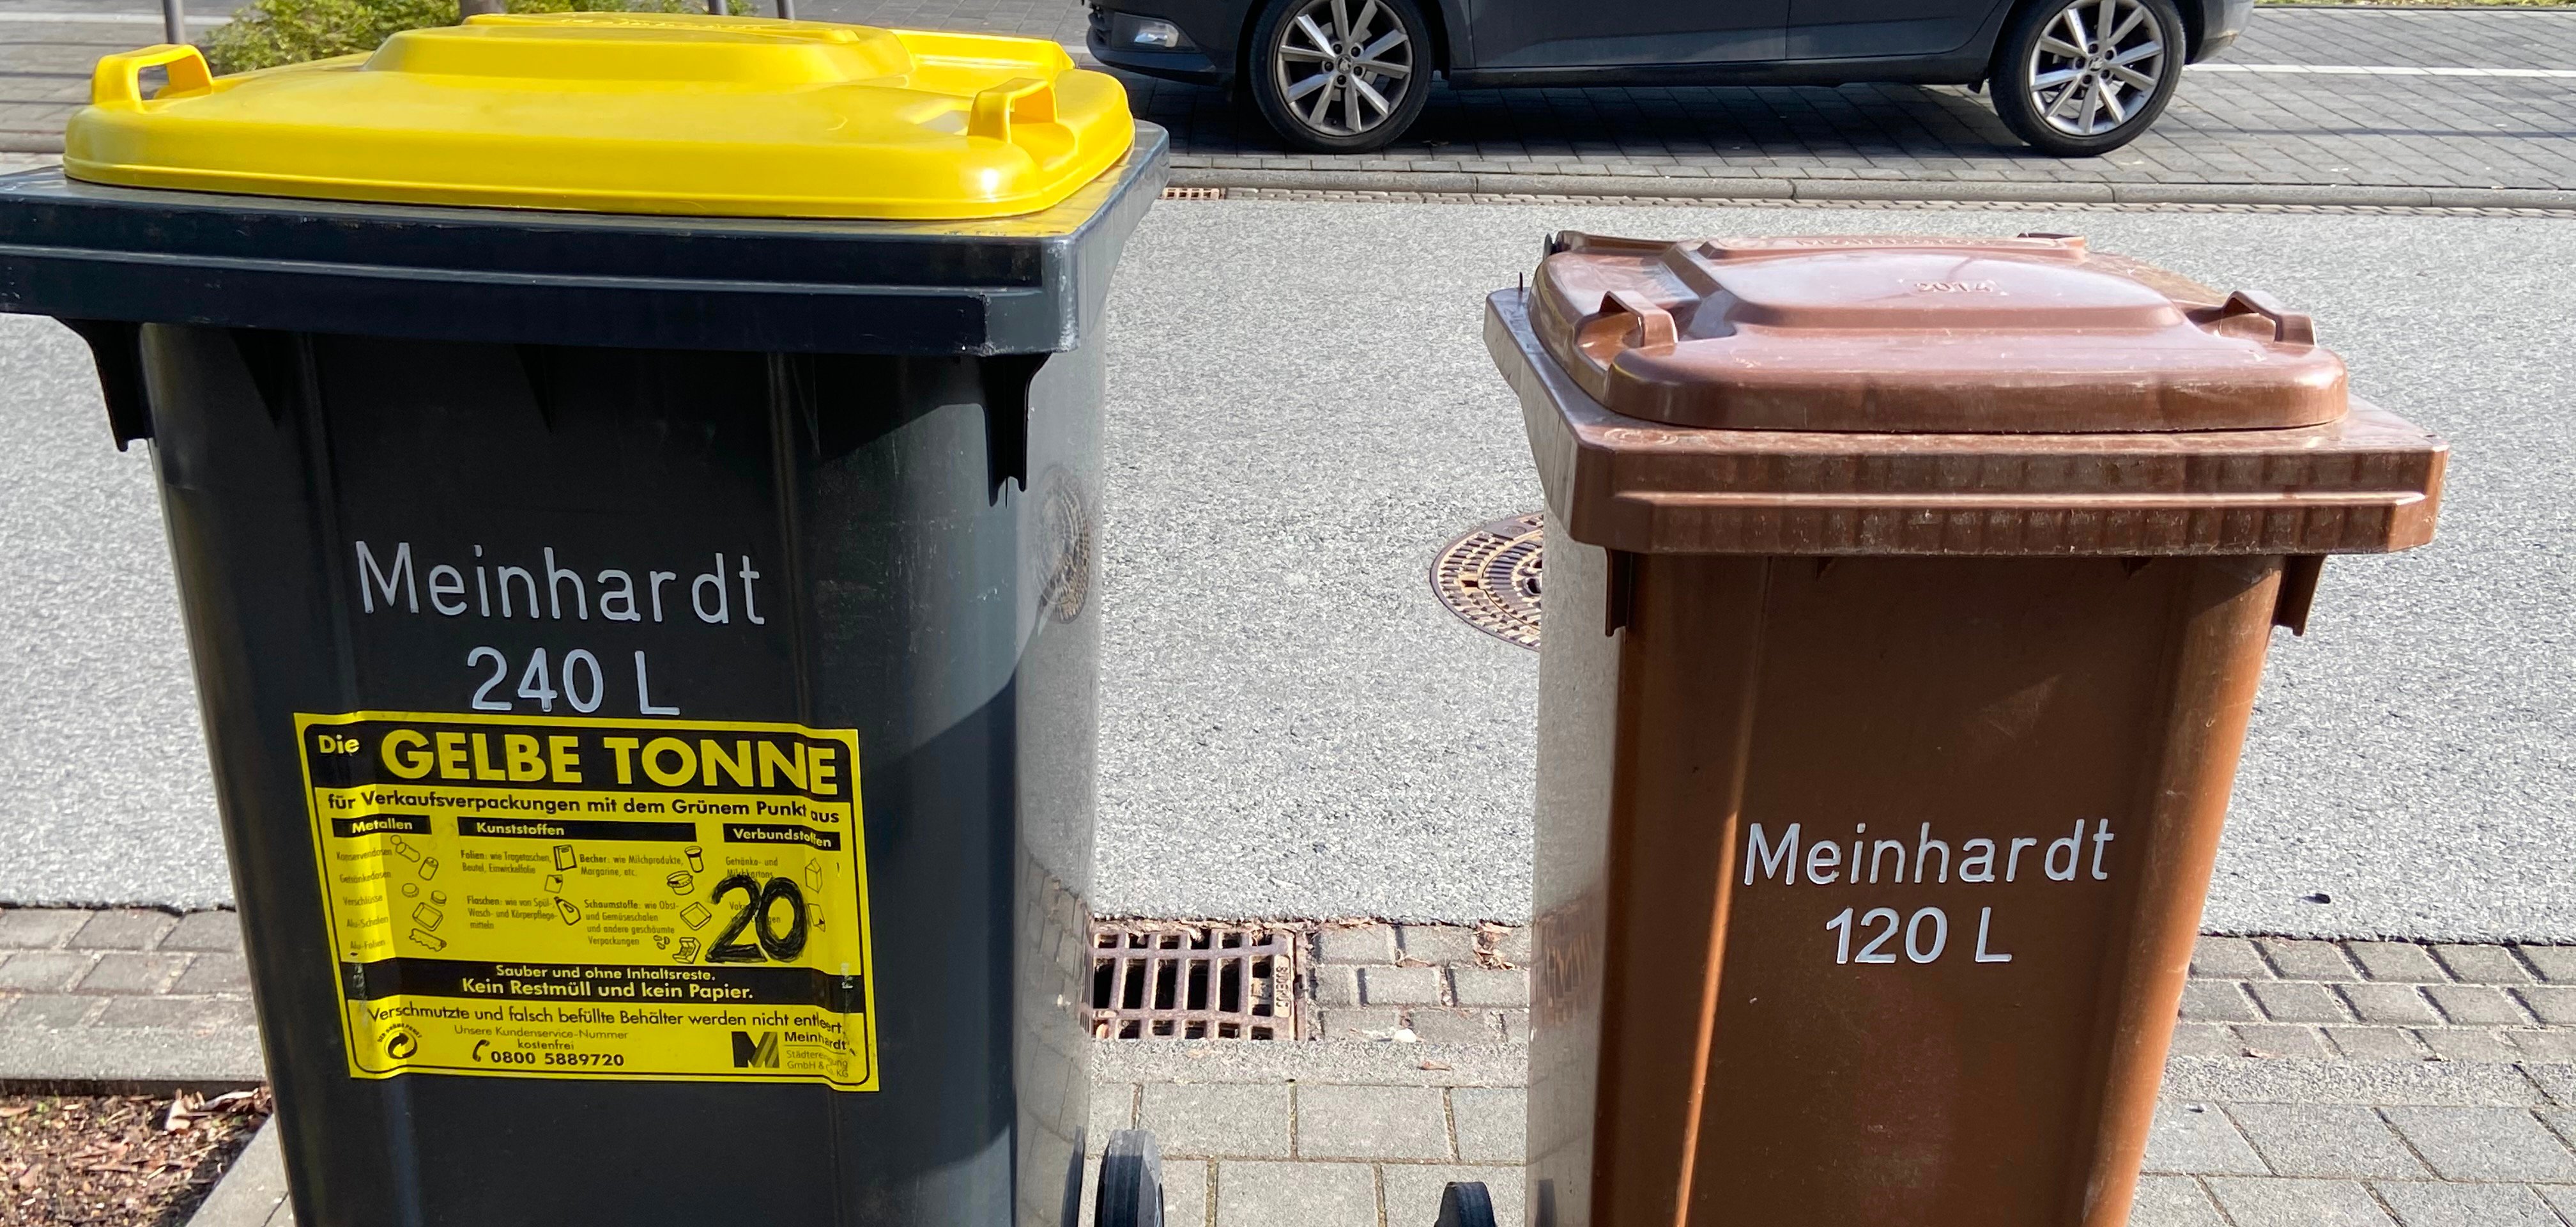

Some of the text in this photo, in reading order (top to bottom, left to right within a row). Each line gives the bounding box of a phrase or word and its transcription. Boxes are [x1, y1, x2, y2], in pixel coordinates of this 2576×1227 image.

[356, 540, 765, 624] Meinhardt
[467, 645, 680, 715] 240 L
[318, 729, 838, 795] Die GELBE TONNE
[328, 790, 839, 823] für Verkaufsverpackungen mit dem Grünem Punkt aus
[352, 820, 413, 834] Metallen
[476, 822, 565, 836] Kunststoffen
[733, 828, 832, 848] Verbundstoffen
[1744, 818, 2115, 886] Meinhardt
[765, 857, 778, 866] und
[343, 895, 383, 906] Verschlüsse
[659, 900, 679, 910] Obst-
[496, 910, 509, 918] und
[586, 912, 658, 922] und Gemüseschalen
[705, 874, 809, 963] 20
[587, 923, 601, 932] und
[1826, 906, 2012, 964] 120 L
[588, 936, 640, 946] Verpackungen
[496, 965, 716, 981] Sauber und ohne Inhaltsreste.
[463, 978, 753, 1002] Kein Restmüll und kein Papier.
[367, 1001, 470, 1022] Verschmutzte
[475, 1006, 503, 1021] und
[509, 1007, 553, 1022] falsch
[558, 1007, 615, 1024] befüllte
[620, 1009, 682, 1026] Behälter
[689, 1011, 746, 1026] werden
[753, 1012, 789, 1026] nicht
[454, 1025, 629, 1040] Unsere Kundenservice-Nummer
[785, 1031, 846, 1050] Meinhardt
[518, 1038, 574, 1050] kostenfrei
[491, 1051, 624, 1067] 0800 5889720
[787, 1061, 816, 1069] GmbH
[837, 1069, 848, 1077] KG
